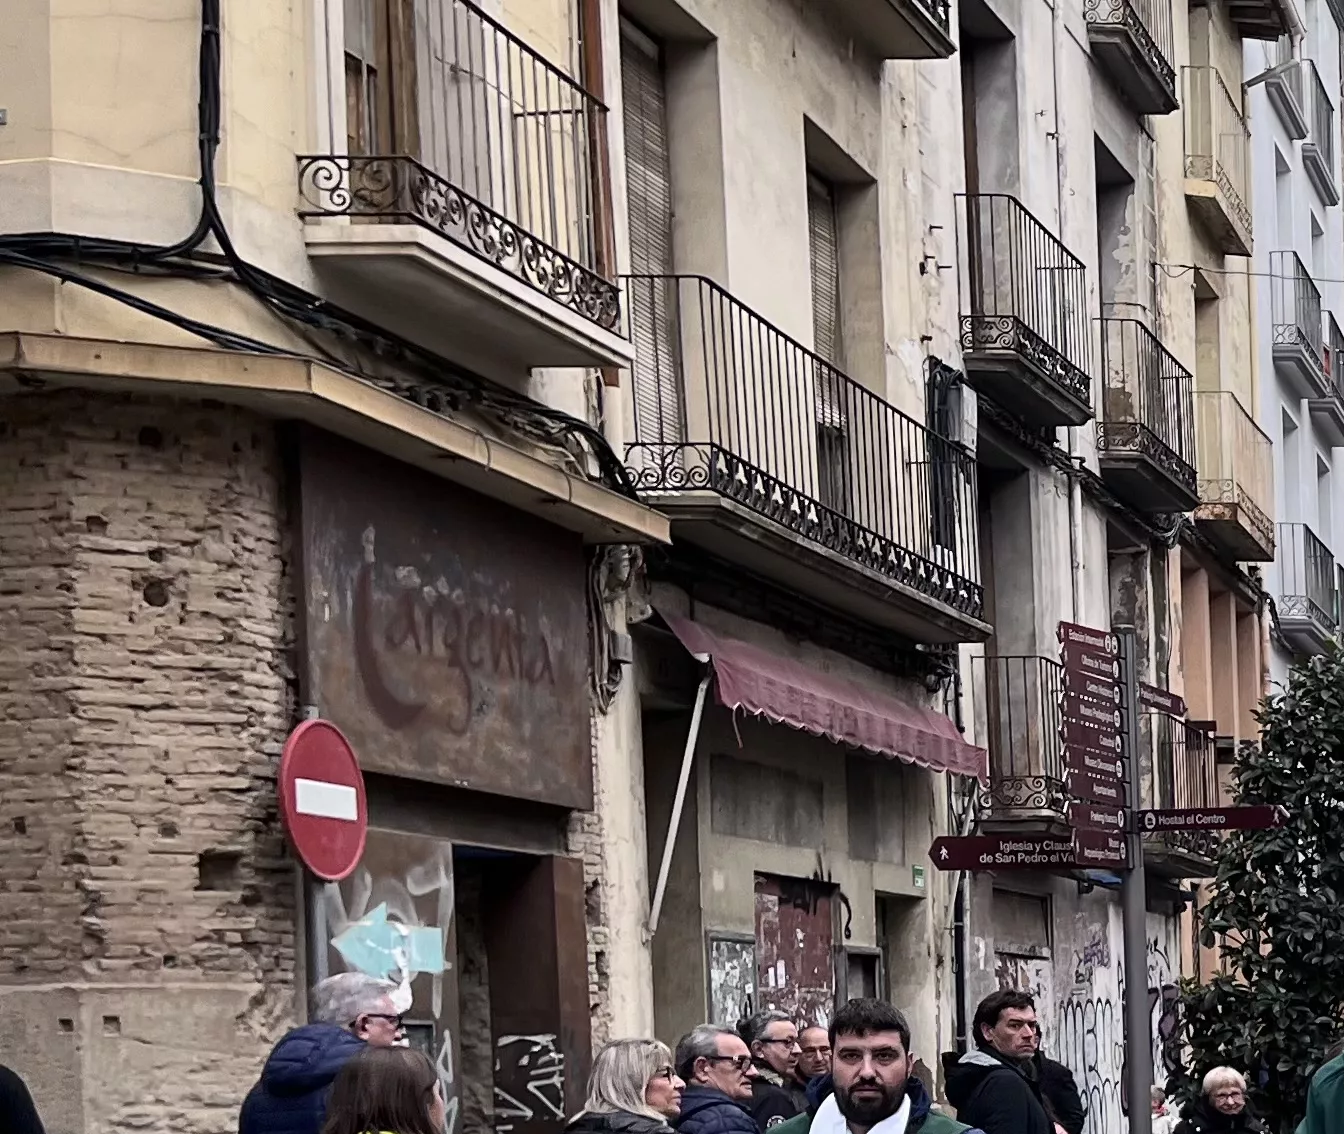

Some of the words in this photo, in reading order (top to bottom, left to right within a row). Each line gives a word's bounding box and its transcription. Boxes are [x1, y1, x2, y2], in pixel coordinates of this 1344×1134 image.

[1158, 814, 1185, 825] Hostal
[1186, 814, 1195, 825] el
[1195, 813, 1226, 824] Centro
[999, 841, 1033, 853] Iglesia
[1034, 842, 1042, 853] y
[1043, 840, 1071, 851] Claus
[979, 852, 994, 863] de
[995, 852, 1016, 863] San
[1017, 852, 1048, 864] Pedro
[1049, 852, 1060, 863] el
